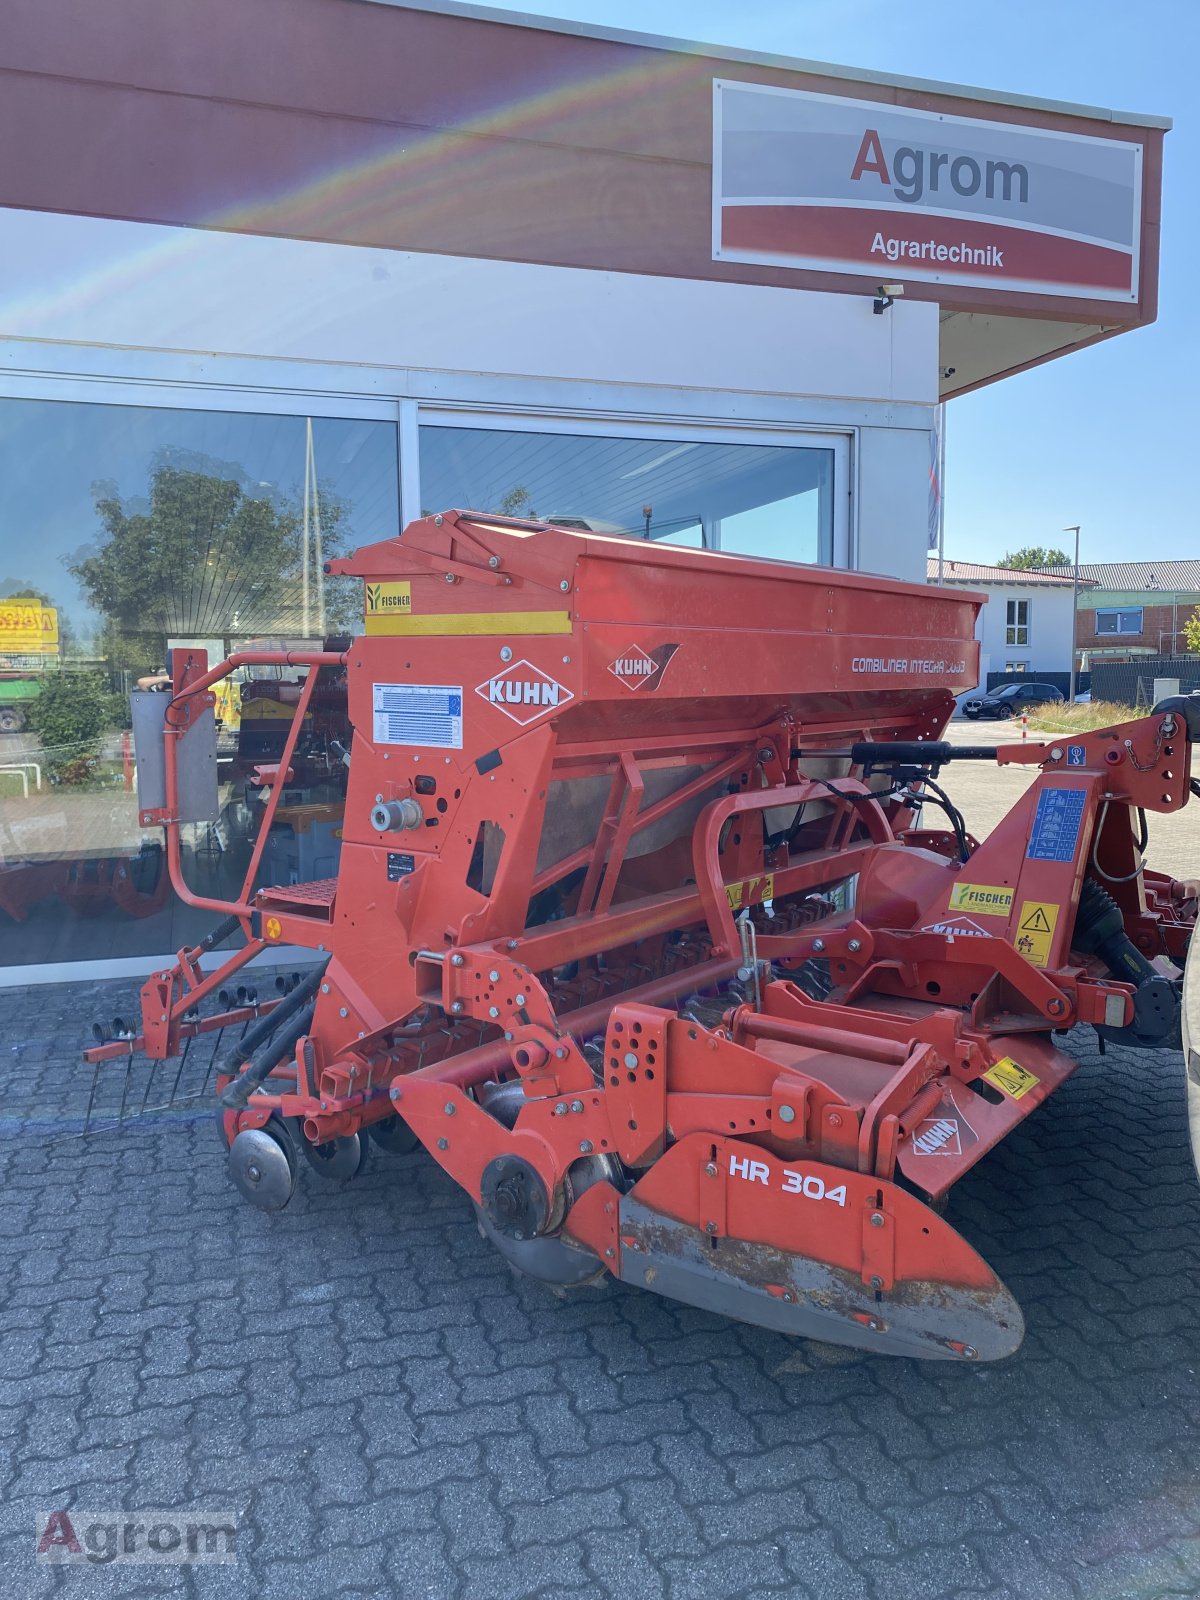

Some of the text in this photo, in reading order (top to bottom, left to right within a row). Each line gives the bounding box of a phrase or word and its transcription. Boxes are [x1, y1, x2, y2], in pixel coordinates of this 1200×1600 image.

[850, 128, 1029, 203] Agrom
[870, 232, 1004, 267] Agrartechnik
[381, 595, 410, 606] FISCHER
[614, 658, 652, 675] KUHN
[851, 657, 907, 673] COMBILINER
[488, 680, 560, 705] KUHN
[968, 891, 1011, 905] FISCHER
[914, 1119, 958, 1154] KUHN
[729, 1155, 847, 1207] HR 304
